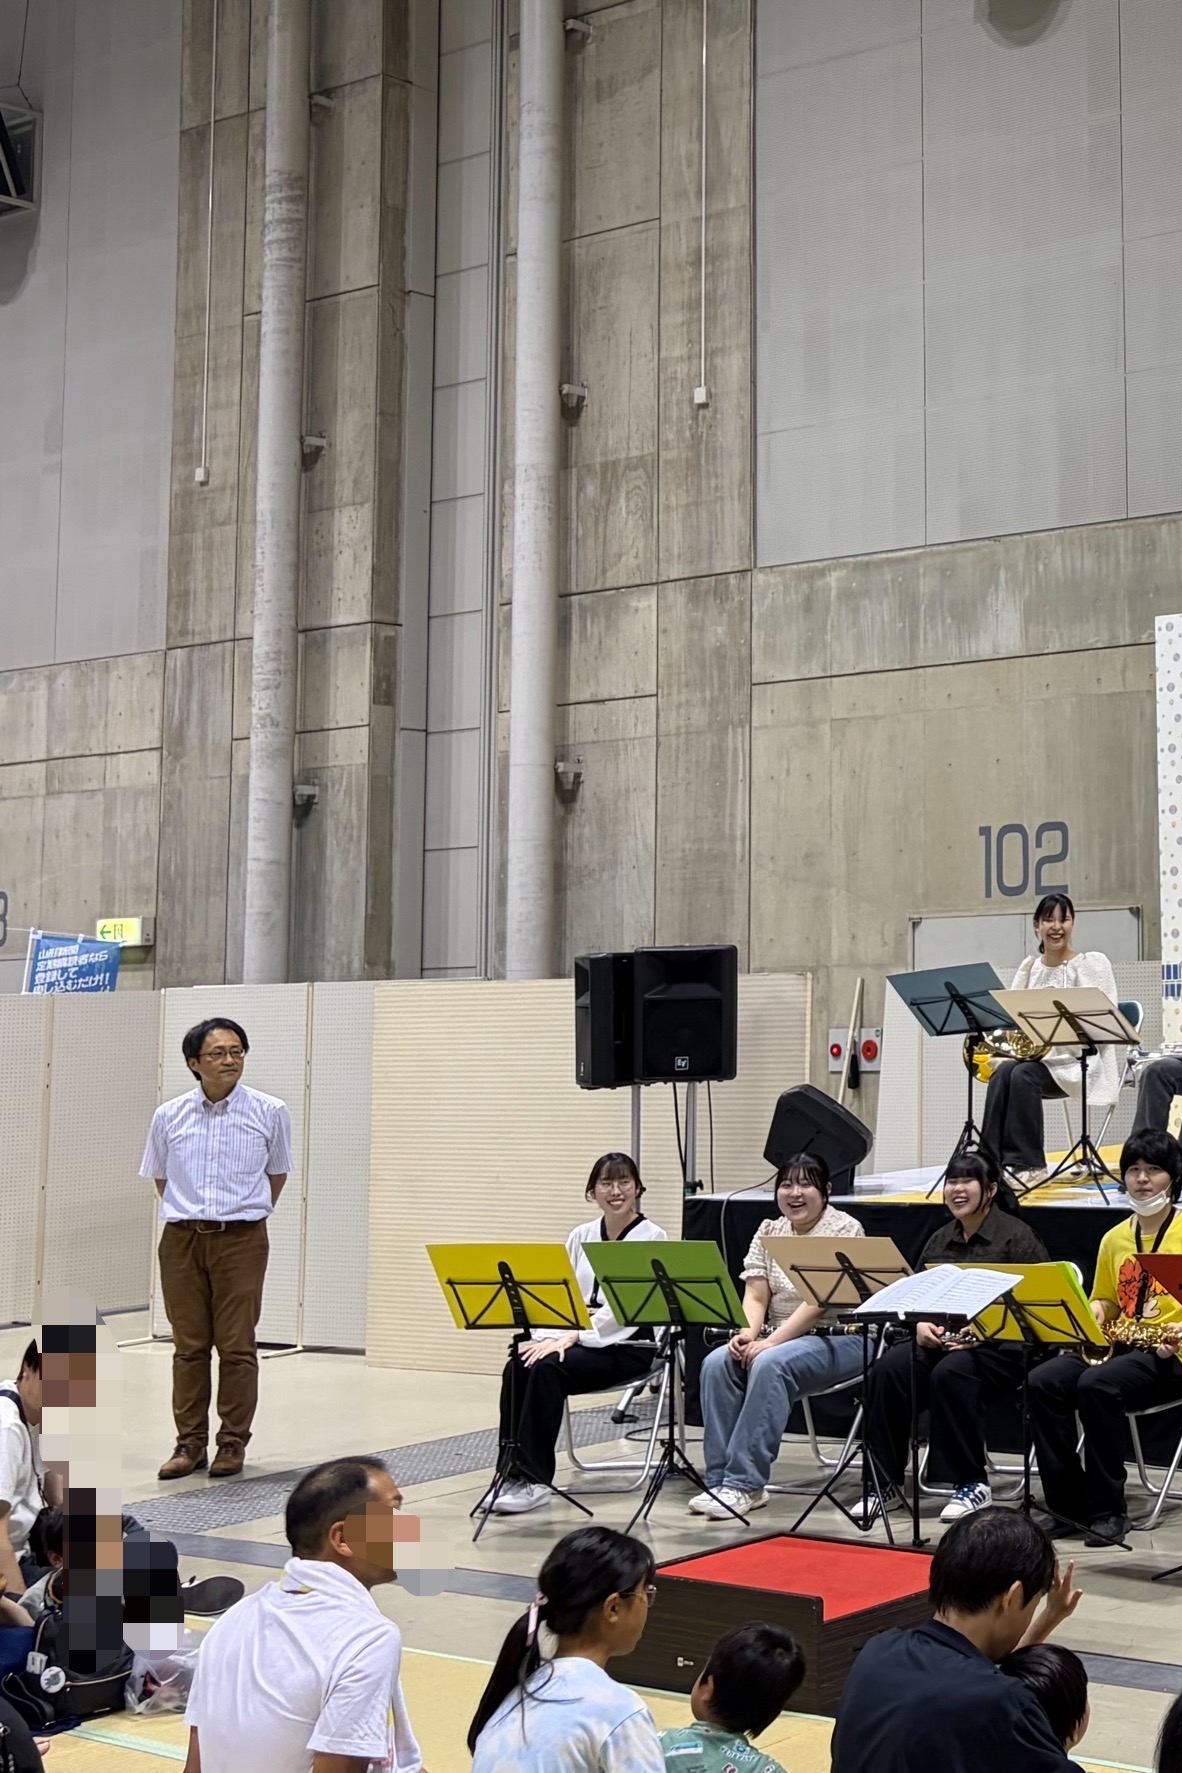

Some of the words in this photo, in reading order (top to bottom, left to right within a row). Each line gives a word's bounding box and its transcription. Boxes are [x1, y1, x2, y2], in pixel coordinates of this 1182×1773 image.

[978, 821, 1069, 898] 102
[34, 966, 79, 985] 登録して
